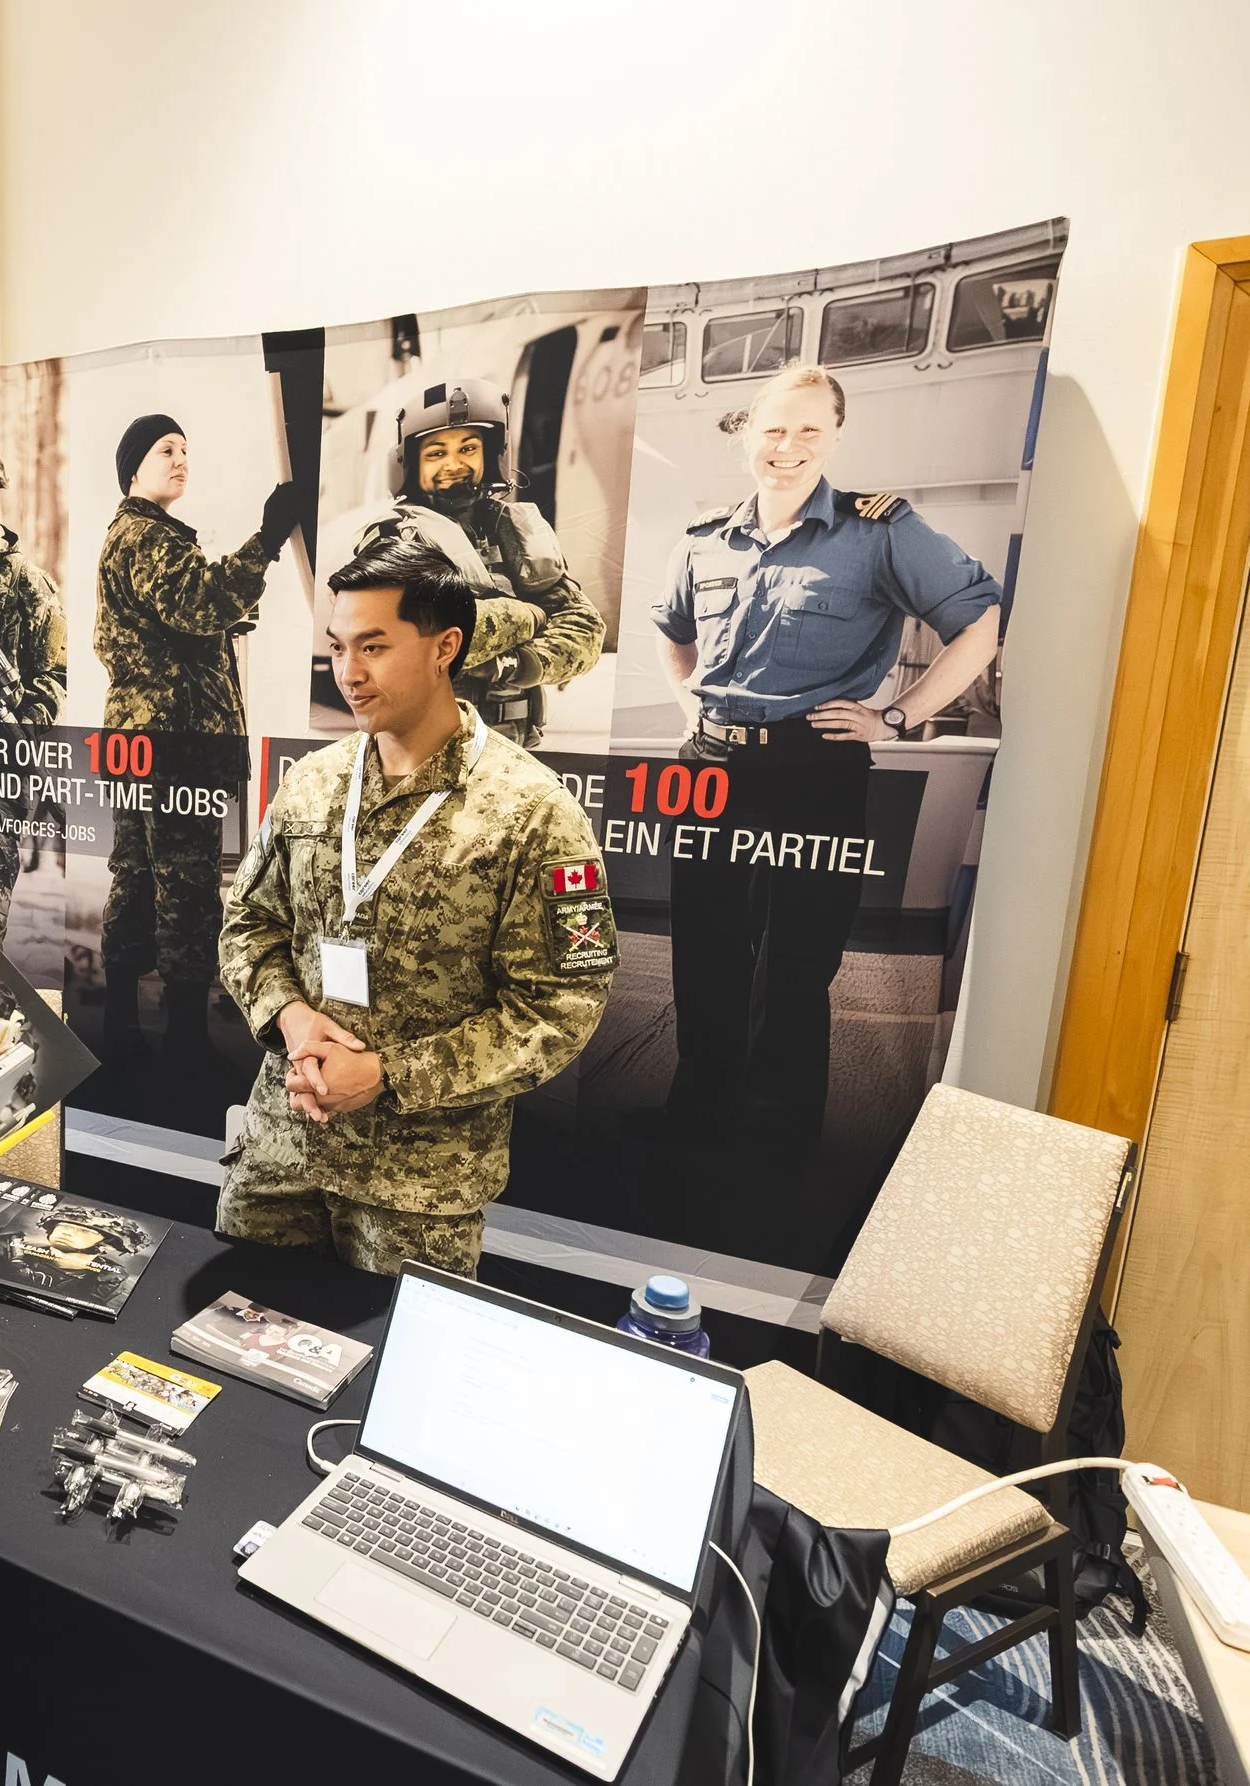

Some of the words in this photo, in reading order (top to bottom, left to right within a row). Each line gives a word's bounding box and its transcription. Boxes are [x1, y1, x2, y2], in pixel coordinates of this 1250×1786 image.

[15, 739, 72, 769] OVER
[84, 731, 153, 777] 100
[29, 775, 153, 812] PART-TIME
[160, 785, 228, 818] JOBS
[625, 762, 729, 819] 100
[673, 825, 720, 860] ET
[730, 829, 885, 876] PARTIEL
[560, 956, 614, 970] RECRUTEMENT
[566, 949, 608, 961] RECRUITING
[288, 1334, 342, 1368] Q&A
